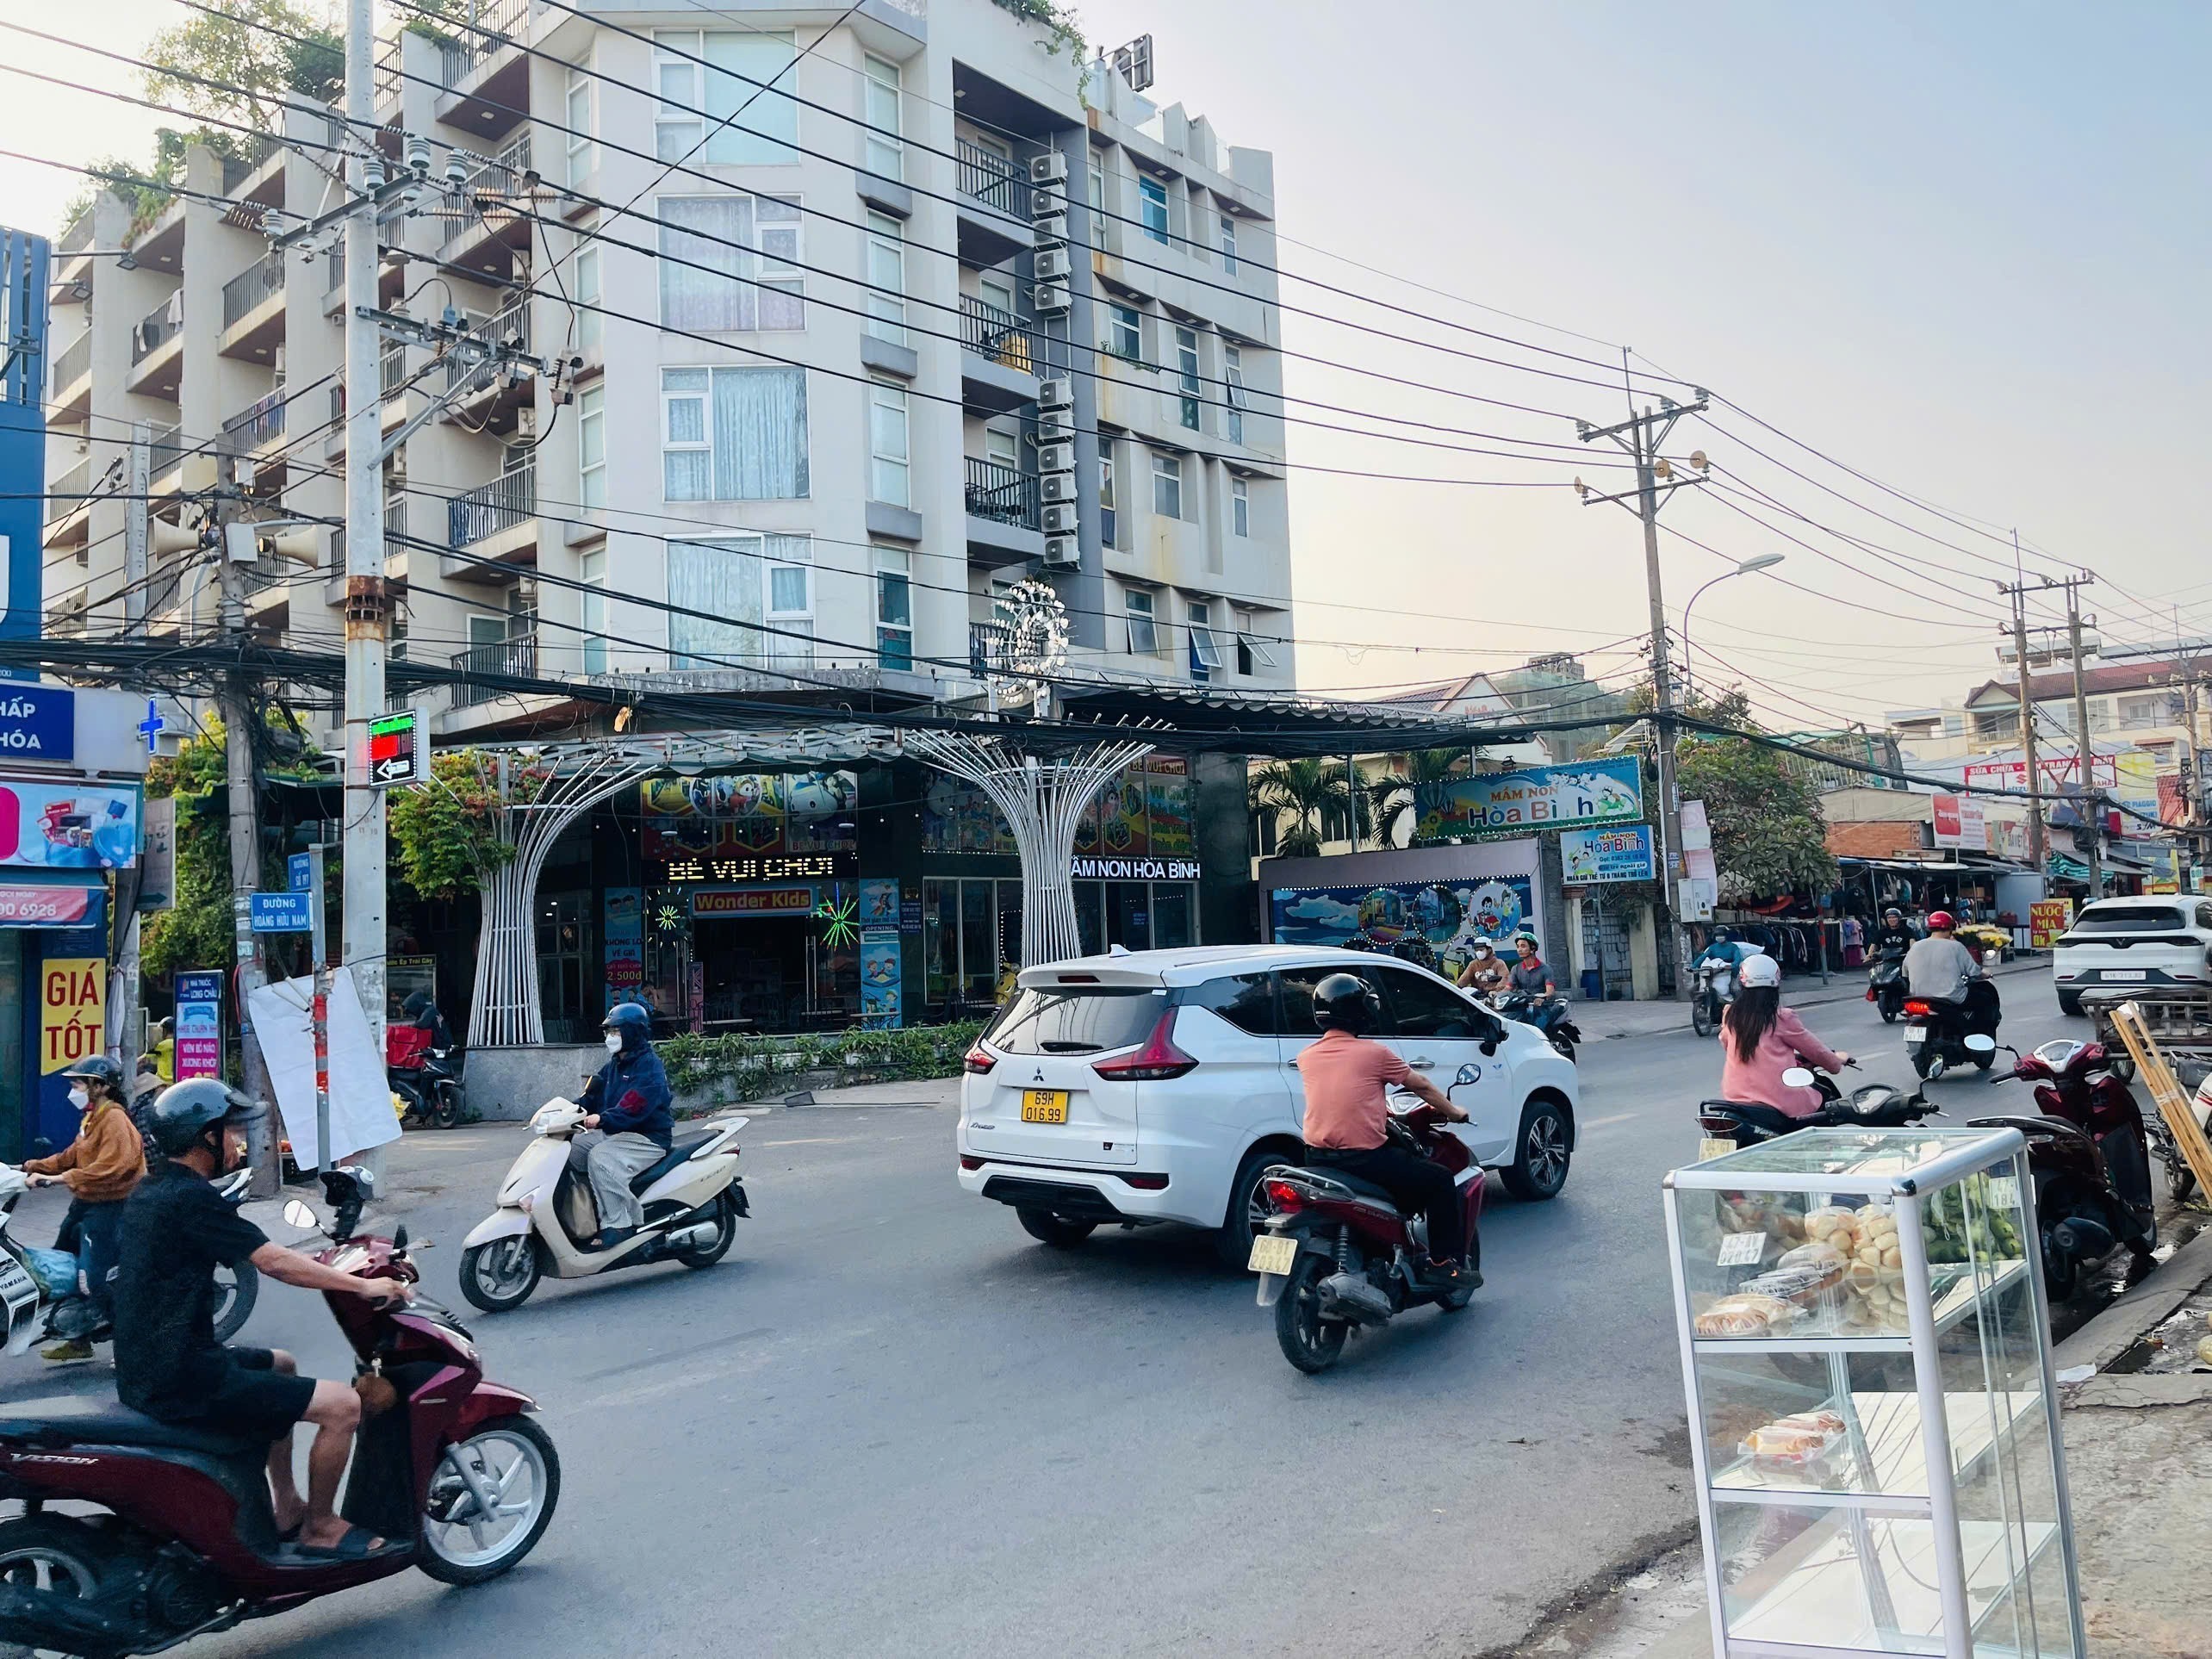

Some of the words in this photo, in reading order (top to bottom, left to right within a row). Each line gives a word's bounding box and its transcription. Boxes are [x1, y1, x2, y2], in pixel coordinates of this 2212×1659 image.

[1527, 785, 1558, 798] NON
[1468, 805, 1523, 828] Hòa
[1532, 797, 1594, 820] Bìh
[1585, 840, 1611, 853] Hòa
[1614, 836, 1645, 852] Bình
[1071, 854, 1096, 877] ẦM
[1098, 860, 1130, 878] NON
[1134, 857, 1166, 879] HÒA
[1168, 858, 1201, 879] BÌNH
[262, 897, 296, 909] ĐƯỜNG
[695, 892, 767, 910] Wonder
[772, 891, 809, 907] Kids
[19, 904, 57, 916] 6928
[291, 915, 307, 926] NAM
[47, 961, 100, 1007] GIÁ
[45, 1009, 103, 1060] TỐT
[1035, 1091, 1054, 1106] 69H
[1026, 1107, 1061, 1122] 016.99
[0, 1275, 28, 1290] YAMAHA
[10, 1452, 99, 1465] VISION
